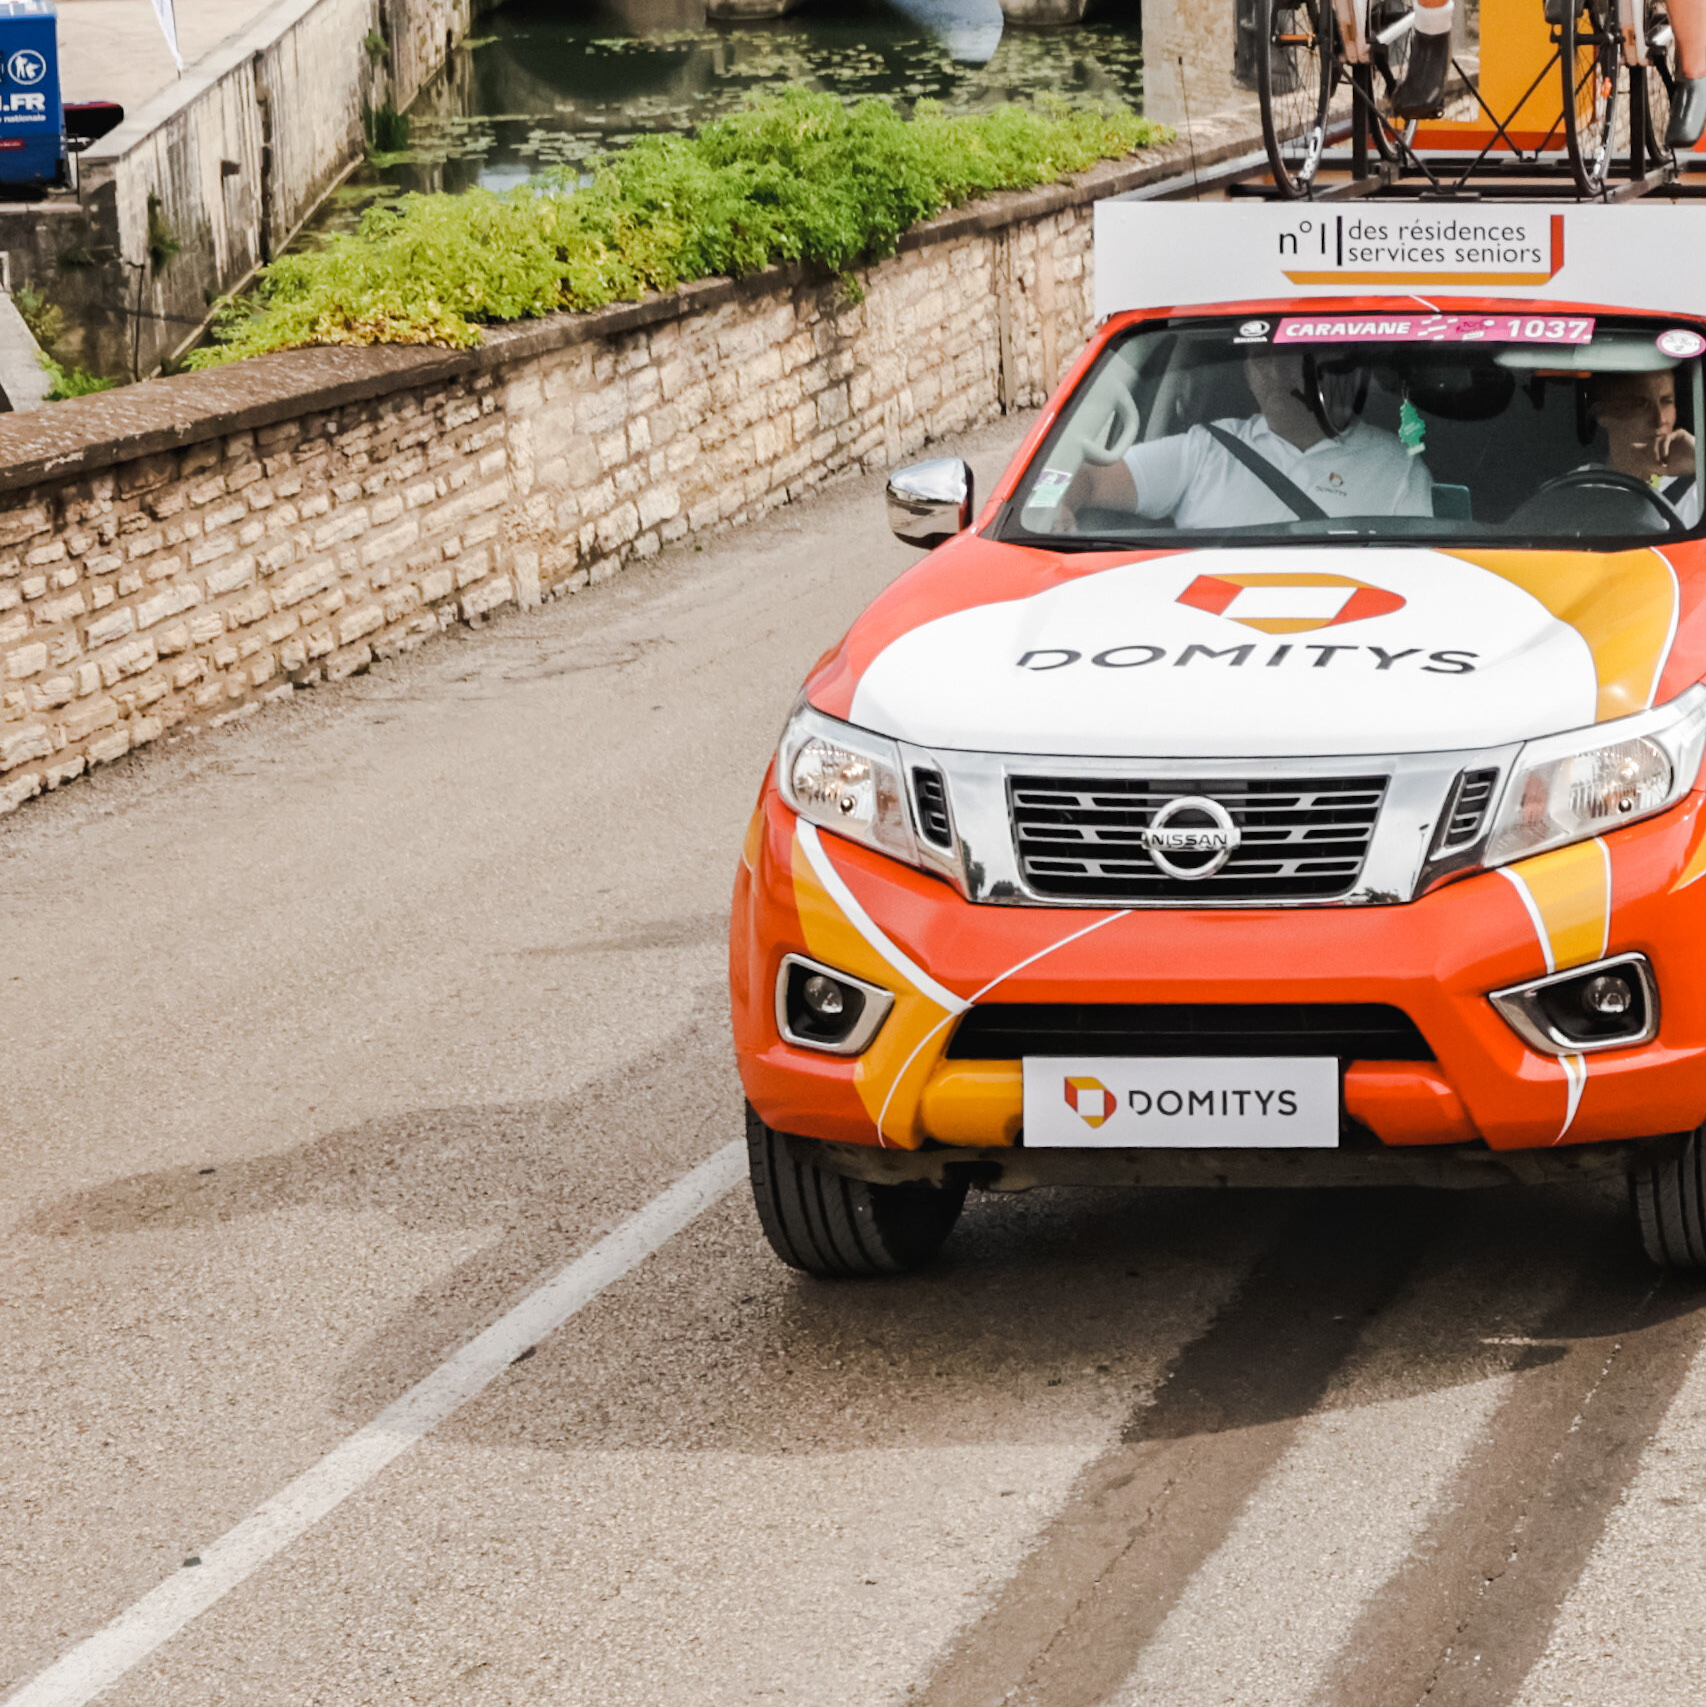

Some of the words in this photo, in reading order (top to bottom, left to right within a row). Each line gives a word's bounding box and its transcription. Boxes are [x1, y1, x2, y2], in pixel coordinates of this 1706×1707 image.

[0, 93, 46, 111] .FR
[4, 114, 46, 123] nationale
[1349, 219, 1388, 240] des
[1400, 219, 1526, 241] résidences
[1349, 243, 1445, 262] services
[1456, 243, 1541, 262] seniors
[1285, 321, 1411, 337] CARAVANE
[1507, 319, 1588, 338] 1037
[1015, 644, 1481, 674] DOMITYS
[1151, 834, 1227, 846] NISSAN
[1129, 1090, 1298, 1116] DOMITYS
